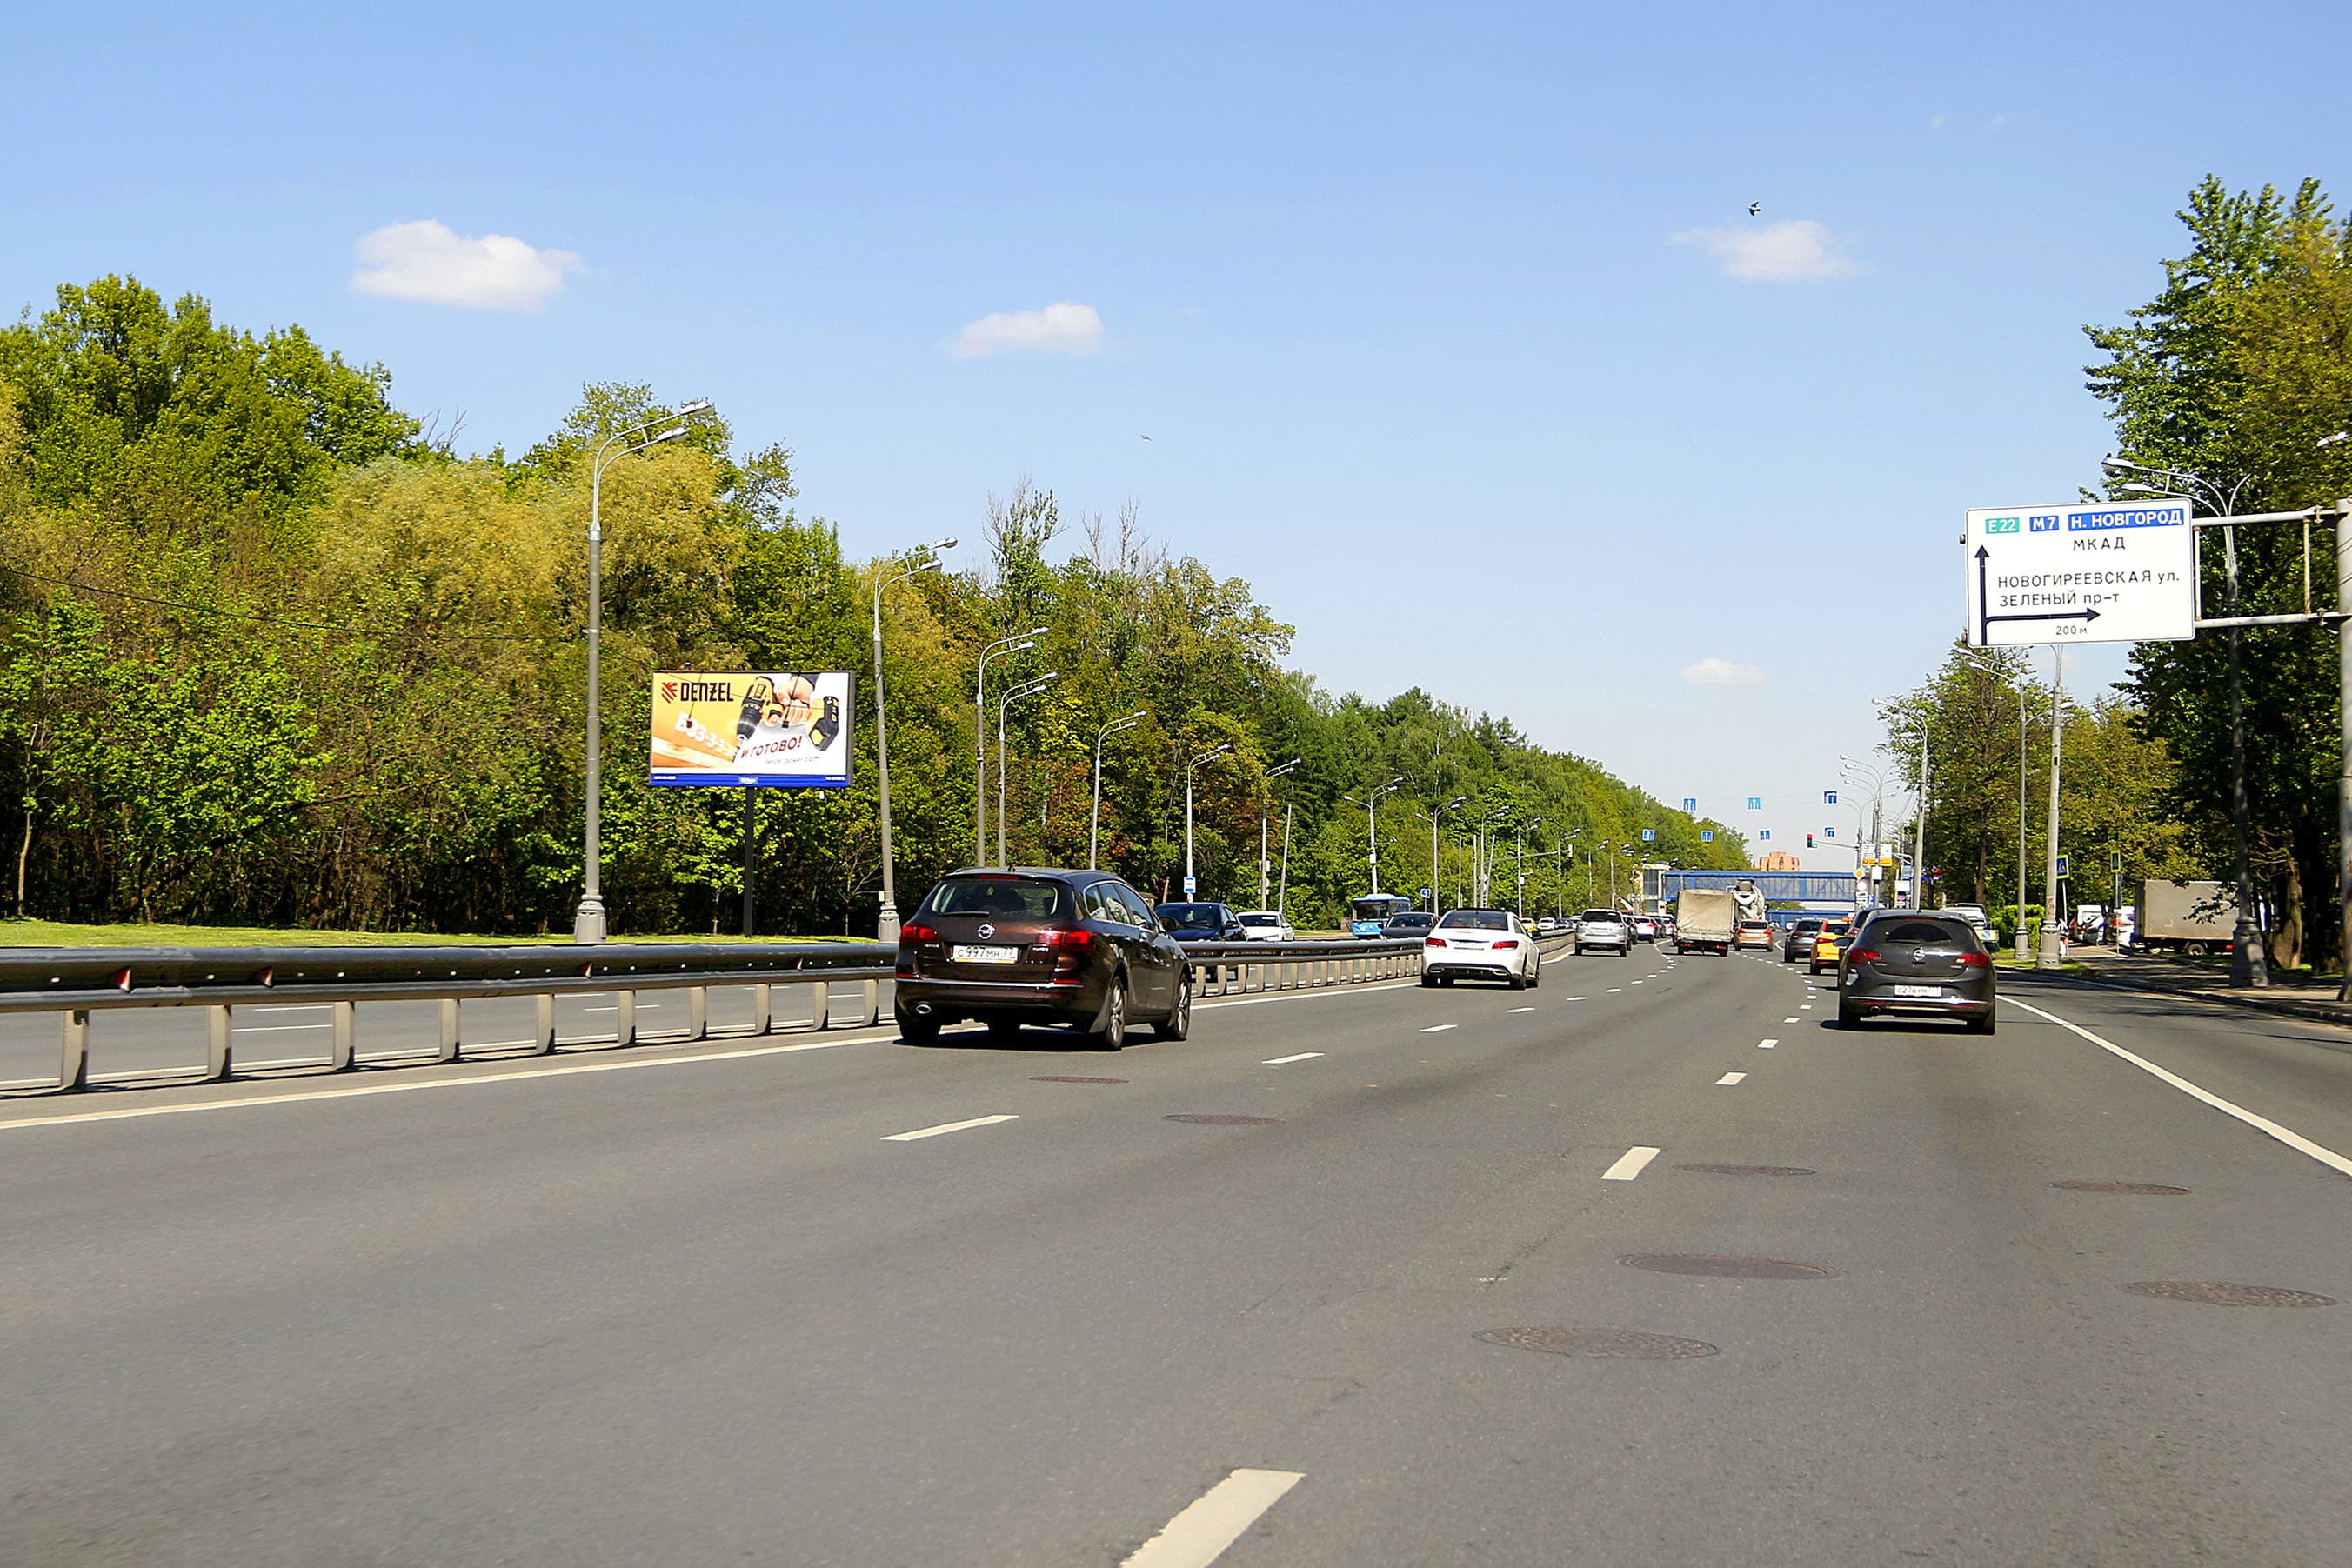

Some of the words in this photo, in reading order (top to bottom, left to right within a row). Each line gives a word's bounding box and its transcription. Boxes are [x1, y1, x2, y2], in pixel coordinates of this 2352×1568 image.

[2071, 514, 2087, 530] Н.
[2092, 510, 2182, 526] НОВГОРОД
[2073, 537, 2126, 551] МКАД
[1998, 570, 2151, 588] НОВОГИРЕЕВСКАЯ
[2158, 571, 2181, 584] ул.
[1999, 590, 2076, 607] ЗЕЛЕНЫЙ
[2083, 593, 2120, 606] пр-т
[680, 683, 734, 702] DENZEL
[751, 736, 802, 757] ГОТОВО!
